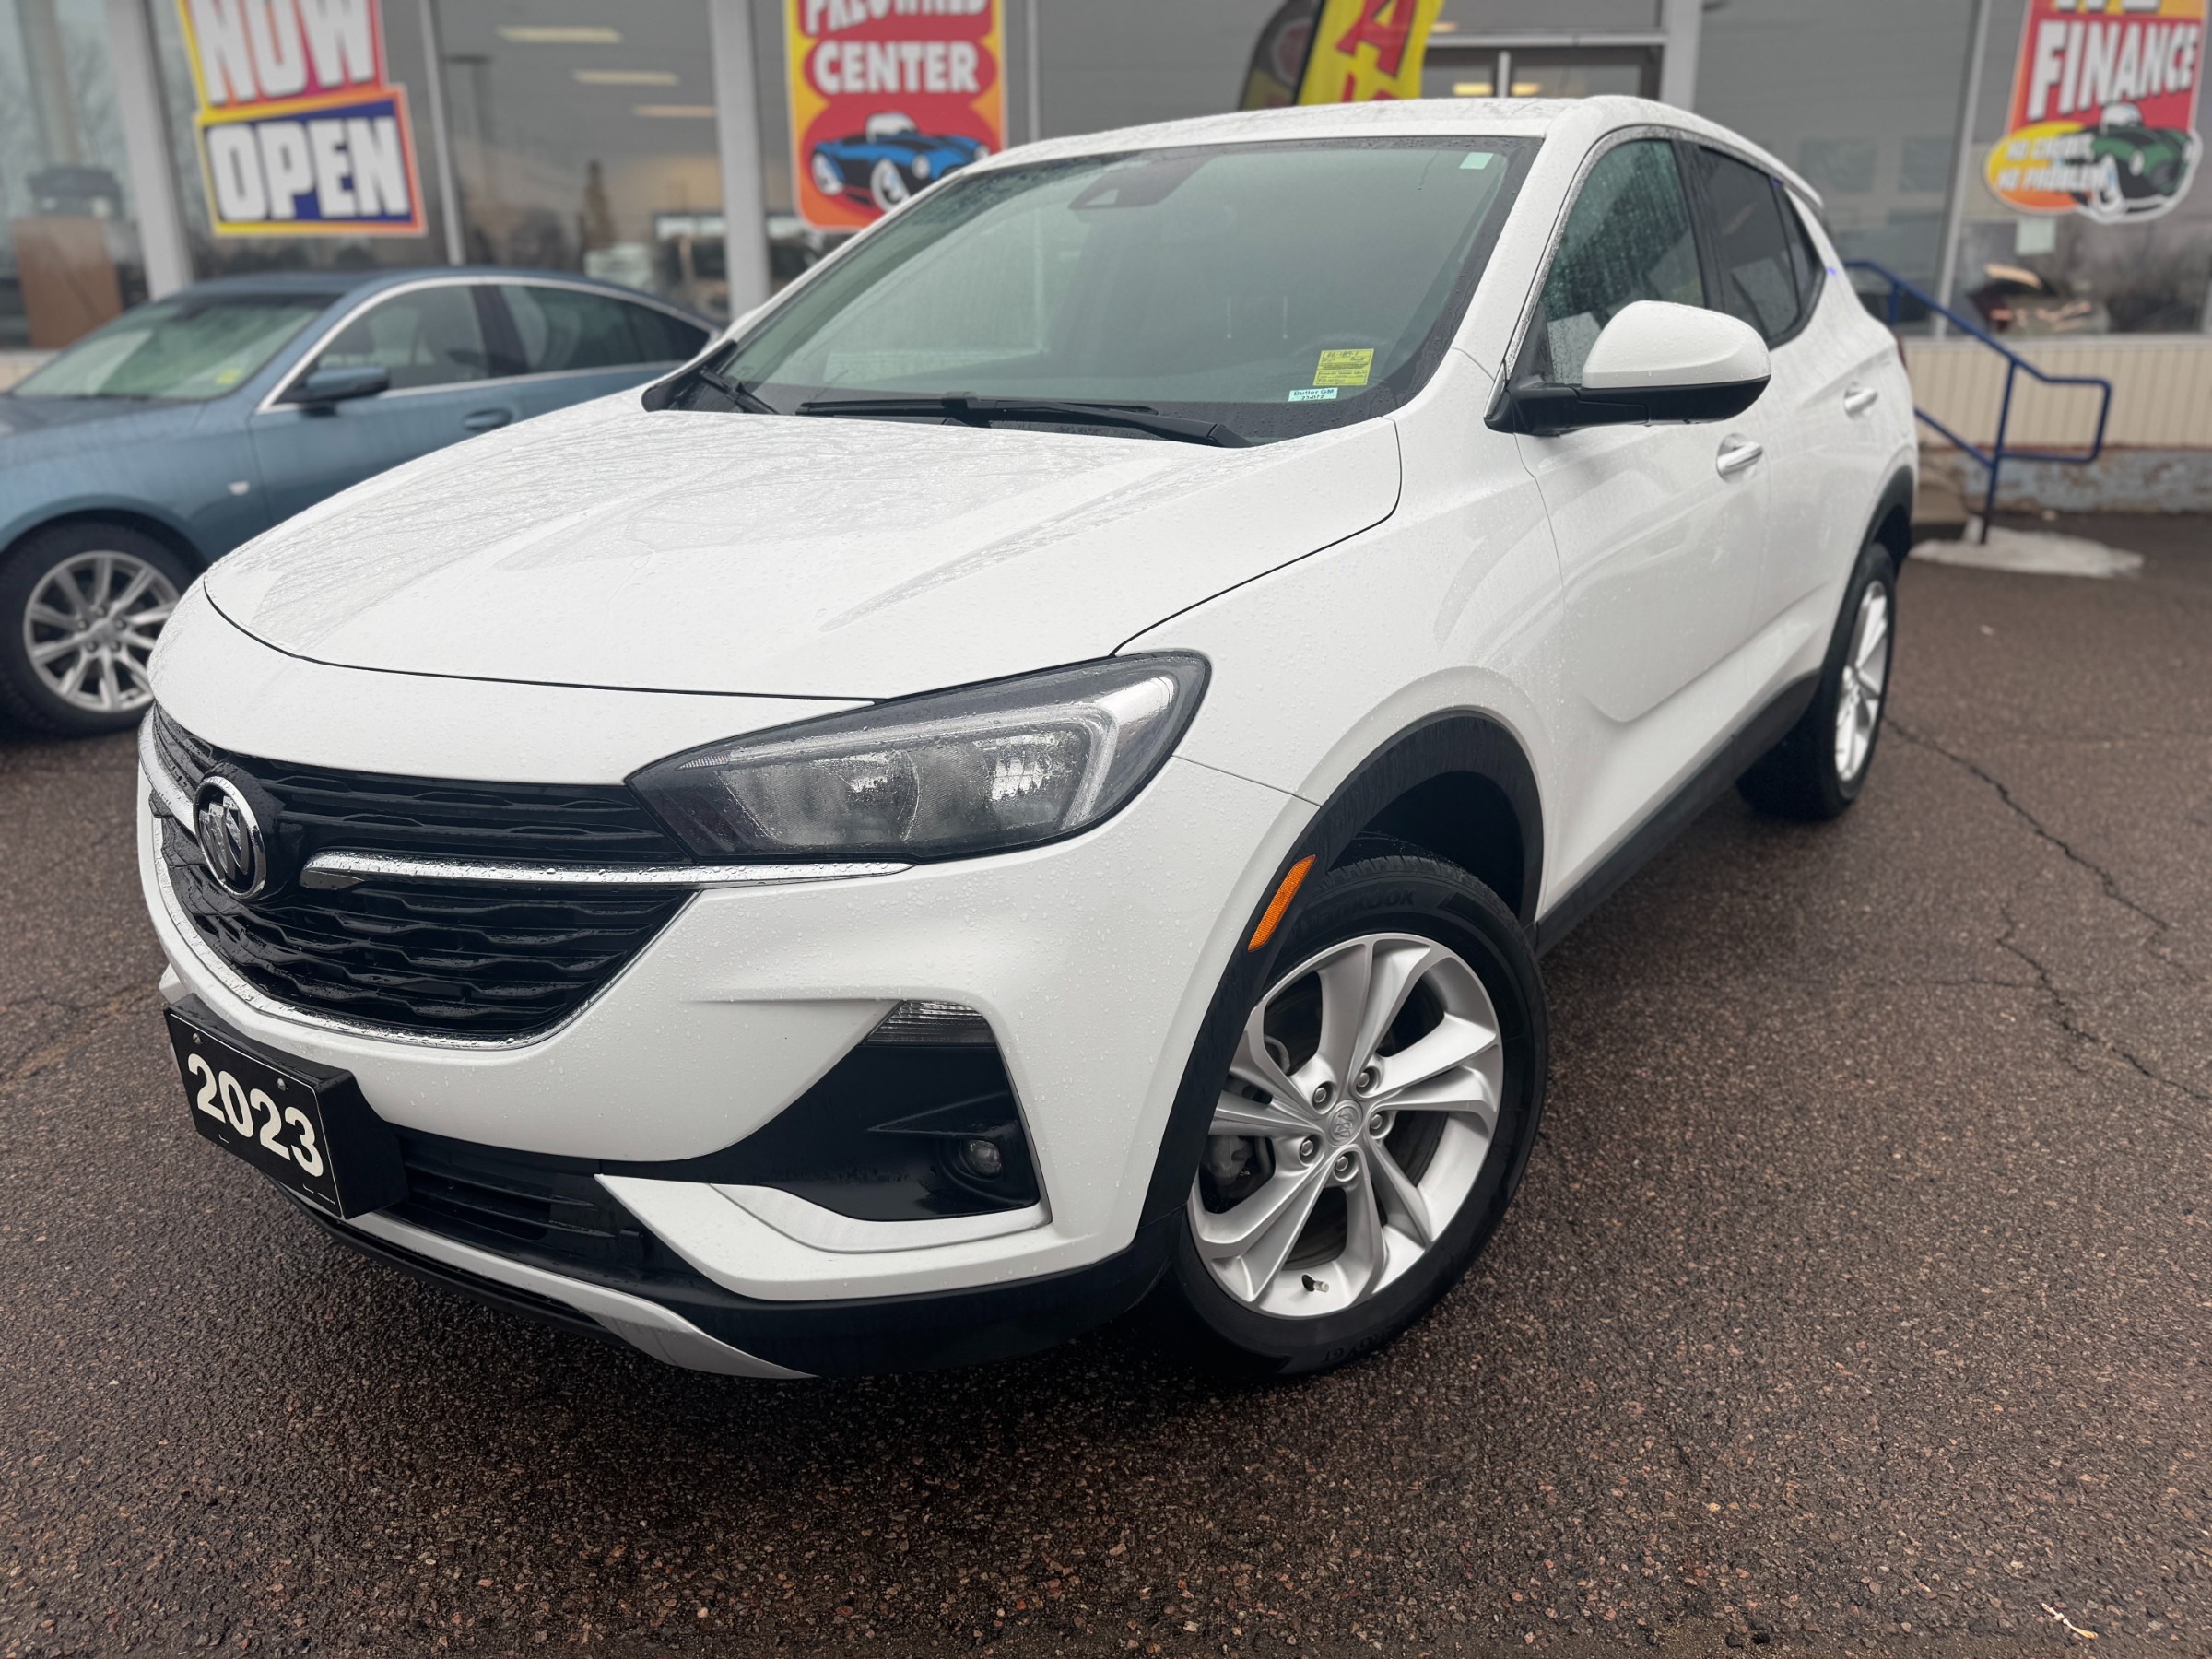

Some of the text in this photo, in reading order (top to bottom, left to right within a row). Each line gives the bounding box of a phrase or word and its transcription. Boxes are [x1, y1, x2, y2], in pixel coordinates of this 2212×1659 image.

[188, 0, 375, 107] NOW
[813, 40, 981, 94] CENTER
[2028, 18, 2200, 121] FINANCE
[206, 116, 411, 220] OPEN
[187, 1053, 324, 1178] 2023
